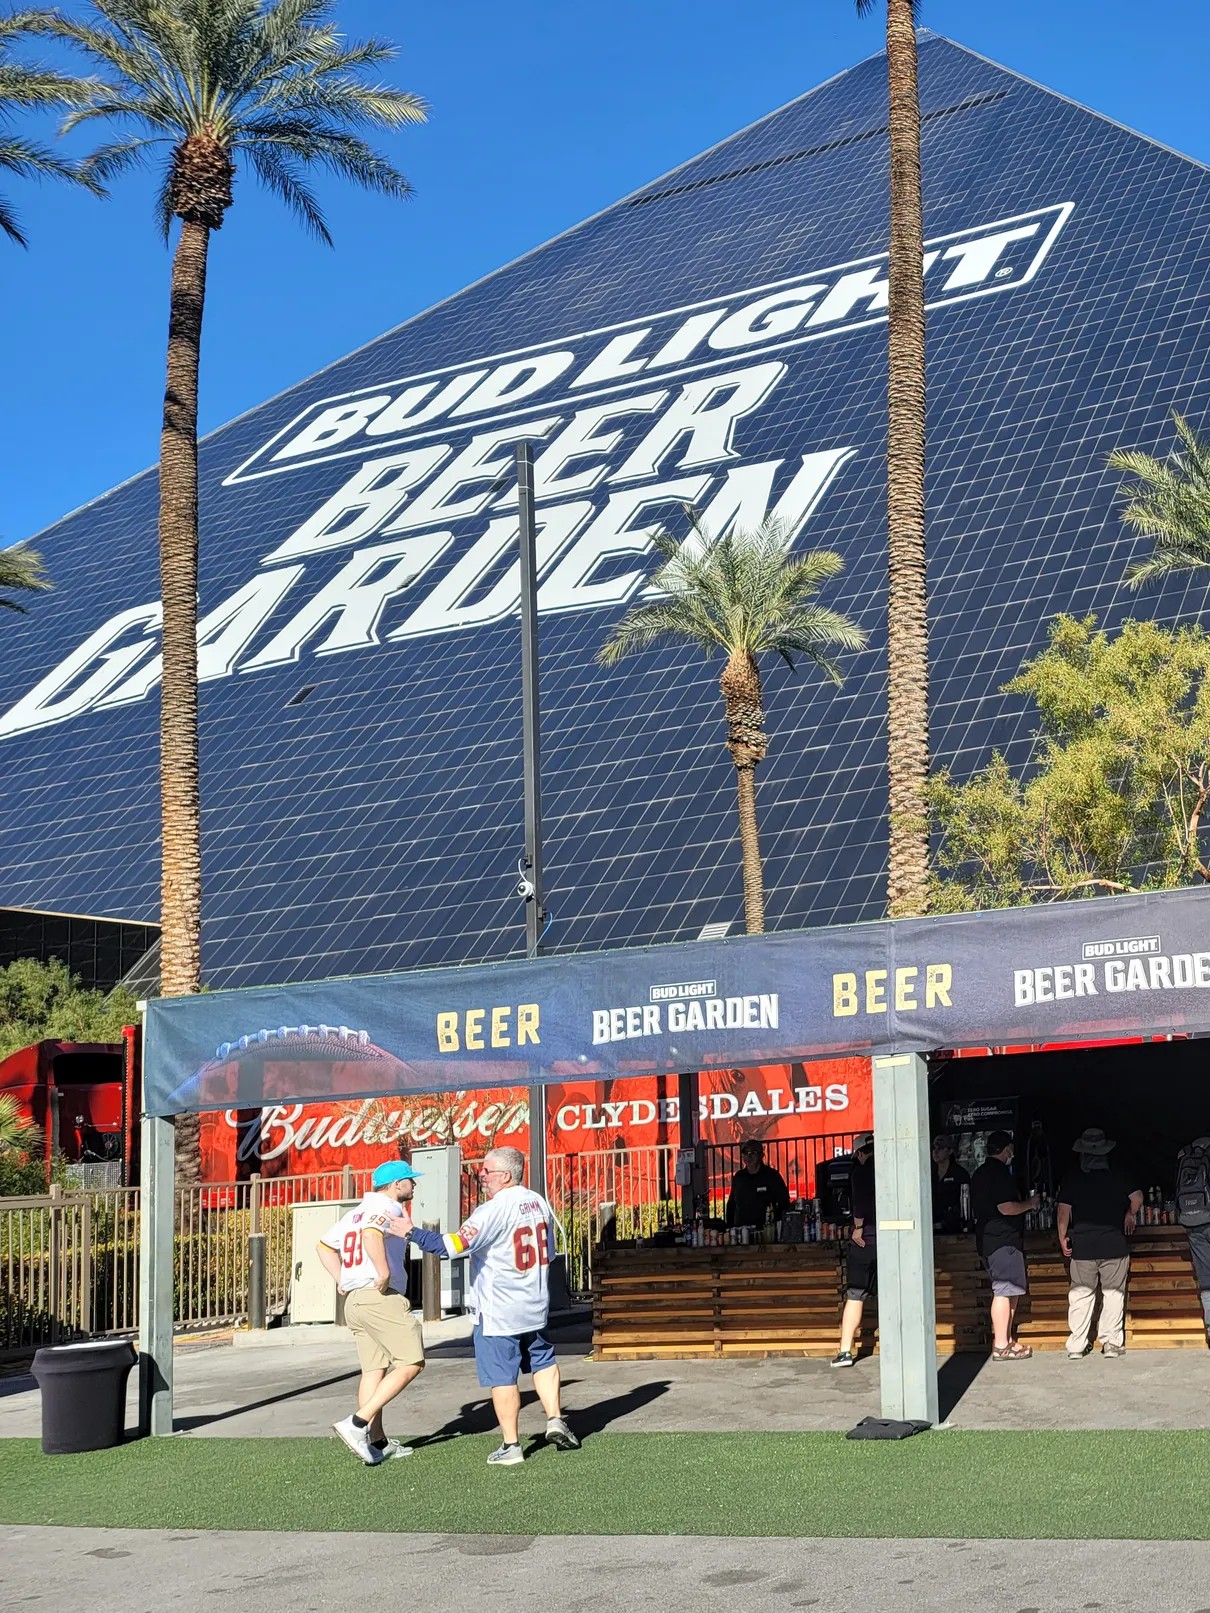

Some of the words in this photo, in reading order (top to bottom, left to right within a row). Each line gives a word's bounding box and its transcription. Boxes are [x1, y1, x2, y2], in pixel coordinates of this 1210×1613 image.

[270, 351, 576, 462] BUD
[568, 222, 1041, 390] LIGHT
[260, 360, 789, 567] BEER
[0, 446, 859, 740] GARDEN
[1084, 943, 1114, 957] BUD
[1115, 938, 1158, 954] LIGHT
[652, 985, 678, 1000] BUD
[678, 982, 715, 997] LIGHT
[831, 963, 953, 1018] BEER
[1013, 963, 1099, 1008] BEER
[435, 1002, 541, 1053] BEER
[592, 1004, 663, 1046] BEER
[667, 993, 779, 1033] GARDEN
